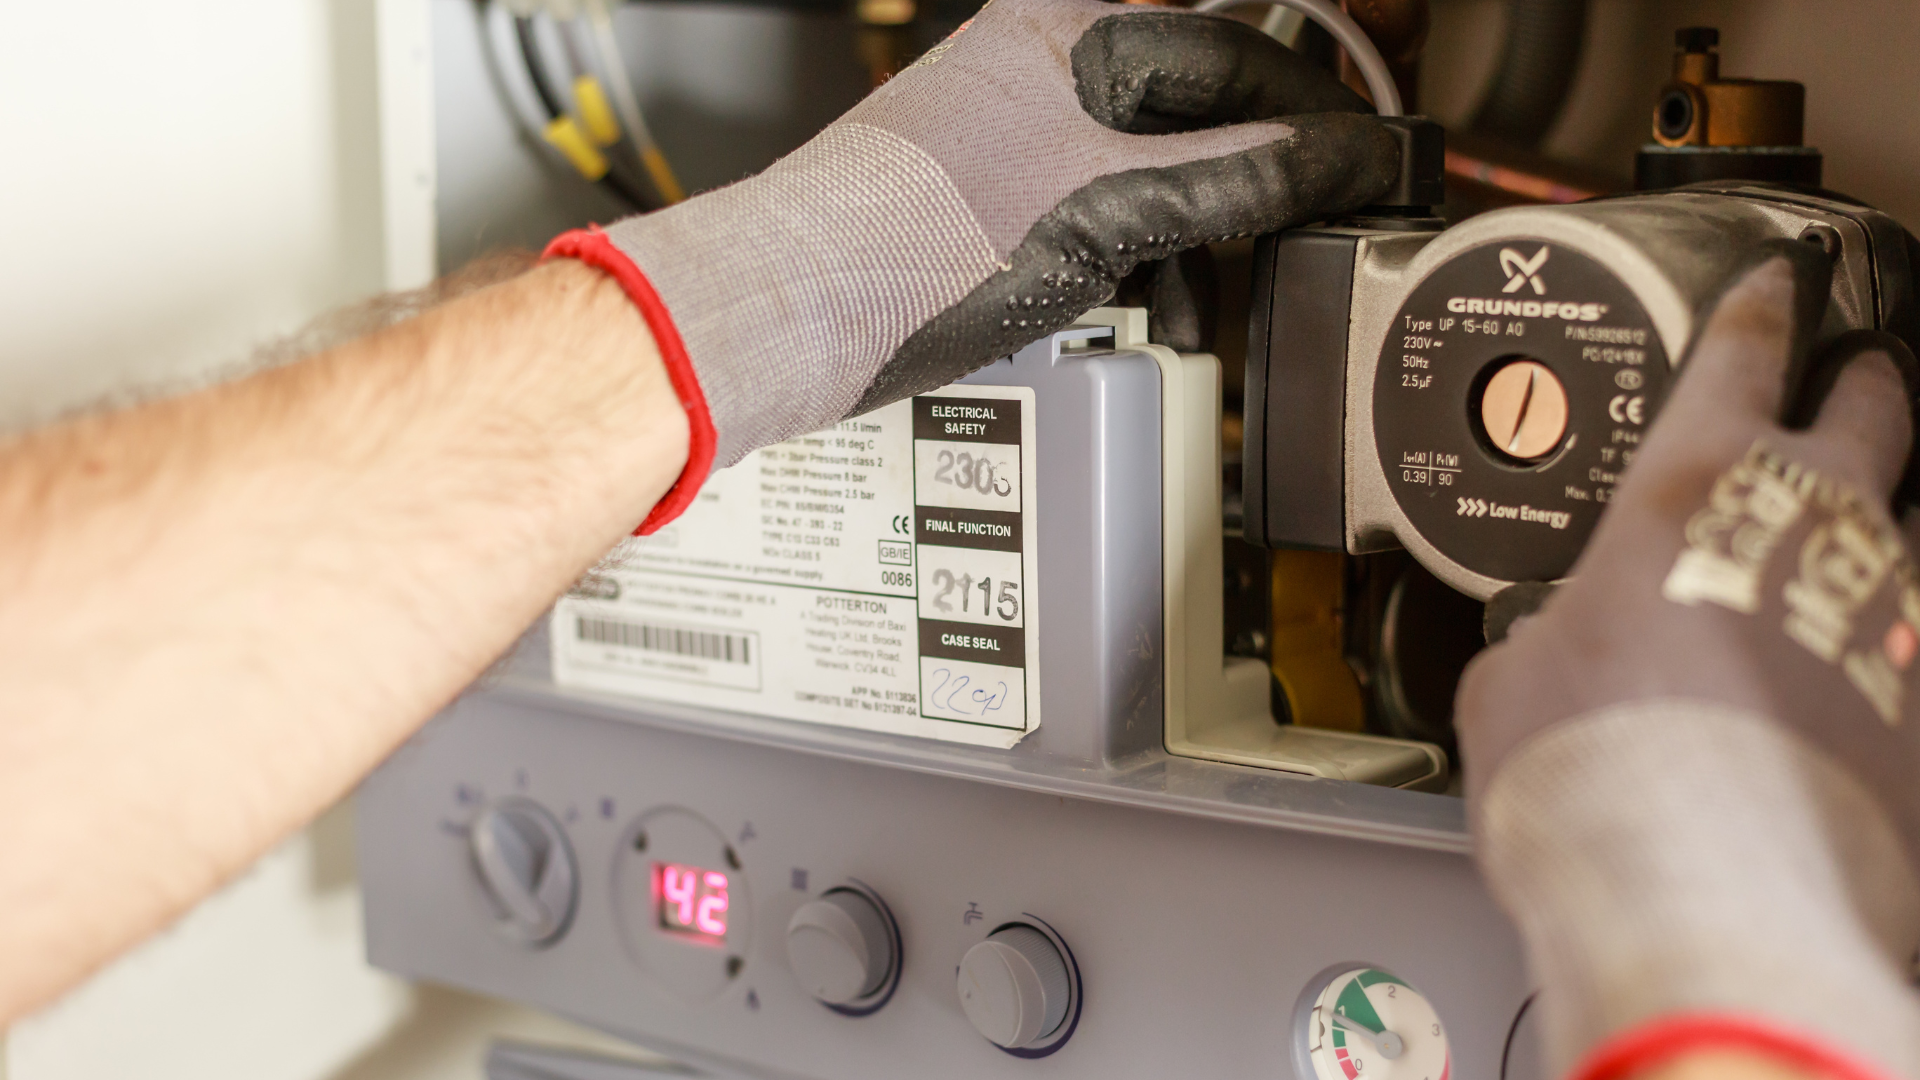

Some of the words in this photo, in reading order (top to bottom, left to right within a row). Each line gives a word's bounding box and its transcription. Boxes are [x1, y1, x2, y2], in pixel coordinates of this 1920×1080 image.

[1447, 296, 1601, 322] GRUNDFOS
[1404, 315, 1433, 333] Type
[1439, 317, 1455, 331] UP
[1462, 318, 1499, 335] 15-60
[1402, 355, 1430, 369] 50Hz
[931, 405, 997, 420] ELECTRICAL
[841, 422, 858, 433] 11.5
[944, 422, 986, 435] SAFETY
[803, 438, 825, 449] temp
[835, 438, 846, 448] 95
[848, 439, 865, 451] deg
[868, 439, 874, 450] C
[810, 453, 849, 465] Pressure
[852, 455, 875, 467] class
[877, 457, 883, 467] 2
[1600, 447, 1616, 463] TF
[803, 469, 842, 481] Pressure
[852, 472, 867, 483] bar
[1403, 470, 1427, 484] 0.39
[1438, 472, 1452, 486] 90
[803, 485, 842, 497] Pressure
[844, 488, 858, 499] 2.5
[860, 490, 875, 501] bar
[1489, 501, 1519, 520] Low
[1520, 504, 1571, 529] Energy
[833, 520, 843, 531] 22
[925, 519, 956, 533] FINAL
[957, 521, 1011, 537] FUNCTION
[880, 547, 910, 560] GB/IE
[881, 570, 913, 587] 0086
[931, 568, 1019, 621] 2115
[816, 596, 887, 614] POTTERTON
[808, 610, 839, 626] Trading
[842, 615, 875, 628] Division
[877, 619, 885, 629] of
[888, 620, 906, 632] Baxi
[805, 627, 837, 641] Heating
[872, 633, 902, 646] Brooks
[941, 633, 970, 648] CASE
[972, 637, 1000, 651] SEAL
[837, 645, 874, 660] Coventry
[854, 662, 878, 675] CV34
[880, 665, 897, 677] 4LL
[662, 866, 729, 935] 42
[1388, 984, 1397, 999] 2
[1337, 1004, 1346, 1016] 1
[1431, 1023, 1441, 1037] 3
[1354, 1058, 1364, 1072] 0
